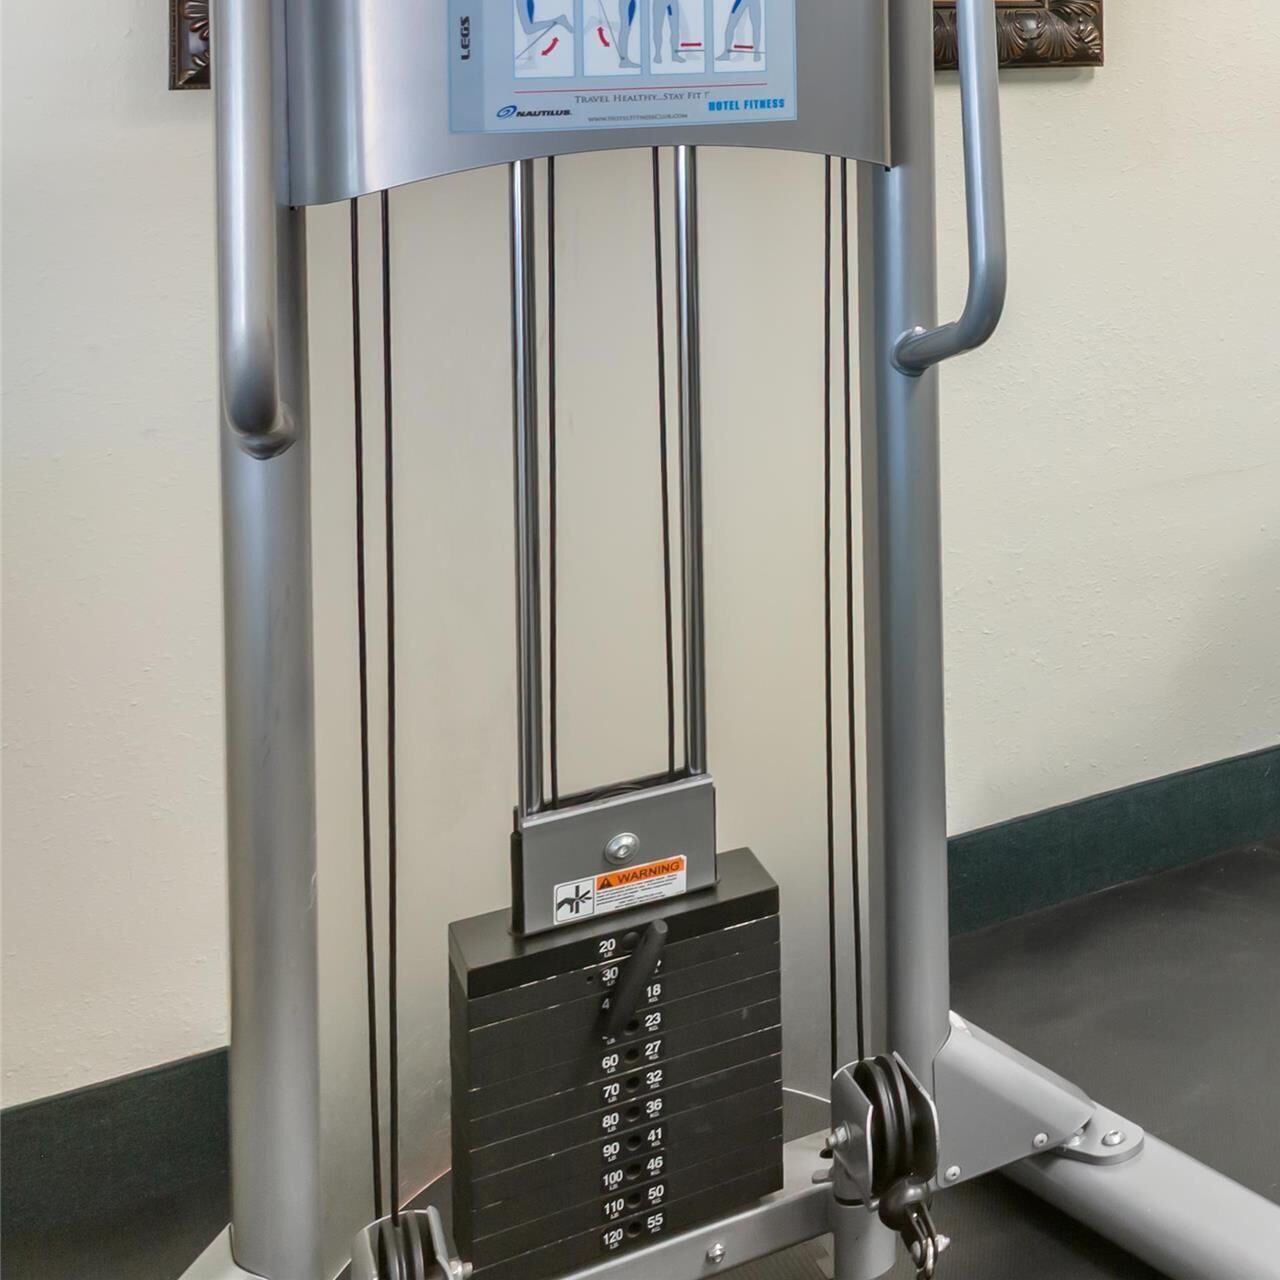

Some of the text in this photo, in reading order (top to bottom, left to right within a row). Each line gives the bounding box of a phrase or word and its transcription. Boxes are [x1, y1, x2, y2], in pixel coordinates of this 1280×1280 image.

[460, 16, 471, 60] LEGS
[708, 98, 785, 112] HOTEL FITNESS
[516, 108, 571, 118] NAUTILUS
[617, 861, 680, 883] WARNING
[599, 938, 616, 953] 20
[602, 967, 618, 981] 30
[646, 983, 661, 998] 18
[602, 998, 610, 1009] 4
[645, 1013, 661, 1027] 23
[645, 1040, 661, 1056] 27
[602, 1054, 619, 1069] 60
[646, 1070, 663, 1084] 32
[603, 1083, 620, 1098] 70
[646, 1098, 663, 1113] 36
[602, 1113, 619, 1128] 80
[647, 1127, 662, 1142] 41
[602, 1142, 620, 1157] 90
[646, 1156, 663, 1171] 46
[602, 1170, 623, 1186] 100
[648, 1184, 664, 1200] 50
[604, 1198, 624, 1215] 110
[647, 1213, 663, 1229] 55
[603, 1228, 624, 1245] 120
